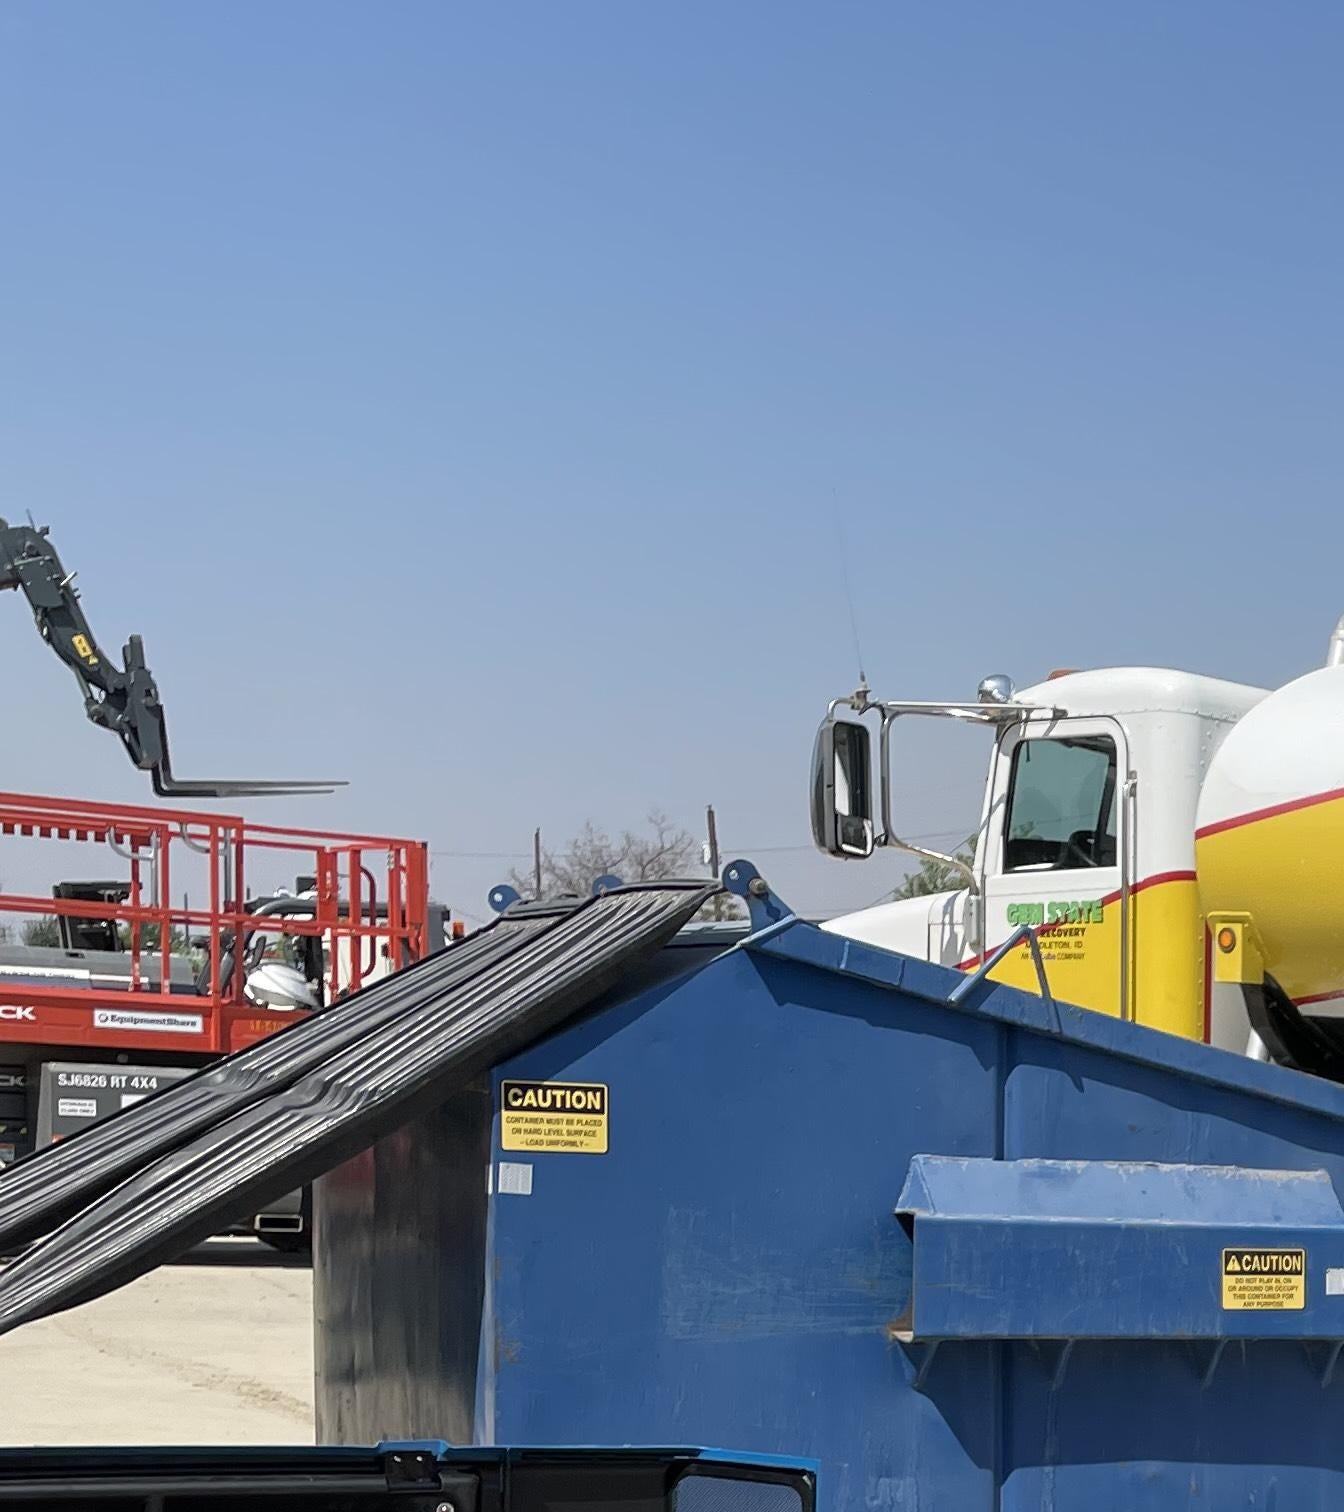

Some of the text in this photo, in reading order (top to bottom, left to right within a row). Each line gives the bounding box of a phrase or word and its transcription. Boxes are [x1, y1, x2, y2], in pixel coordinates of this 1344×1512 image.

[1007, 901, 1104, 926] GEM STATE
[110, 1014, 197, 1027] EquipmentShare
[130, 1077, 157, 1089] 4X4
[507, 1088, 601, 1110] CAUTION
[1241, 1255, 1301, 1271] CAUTION
